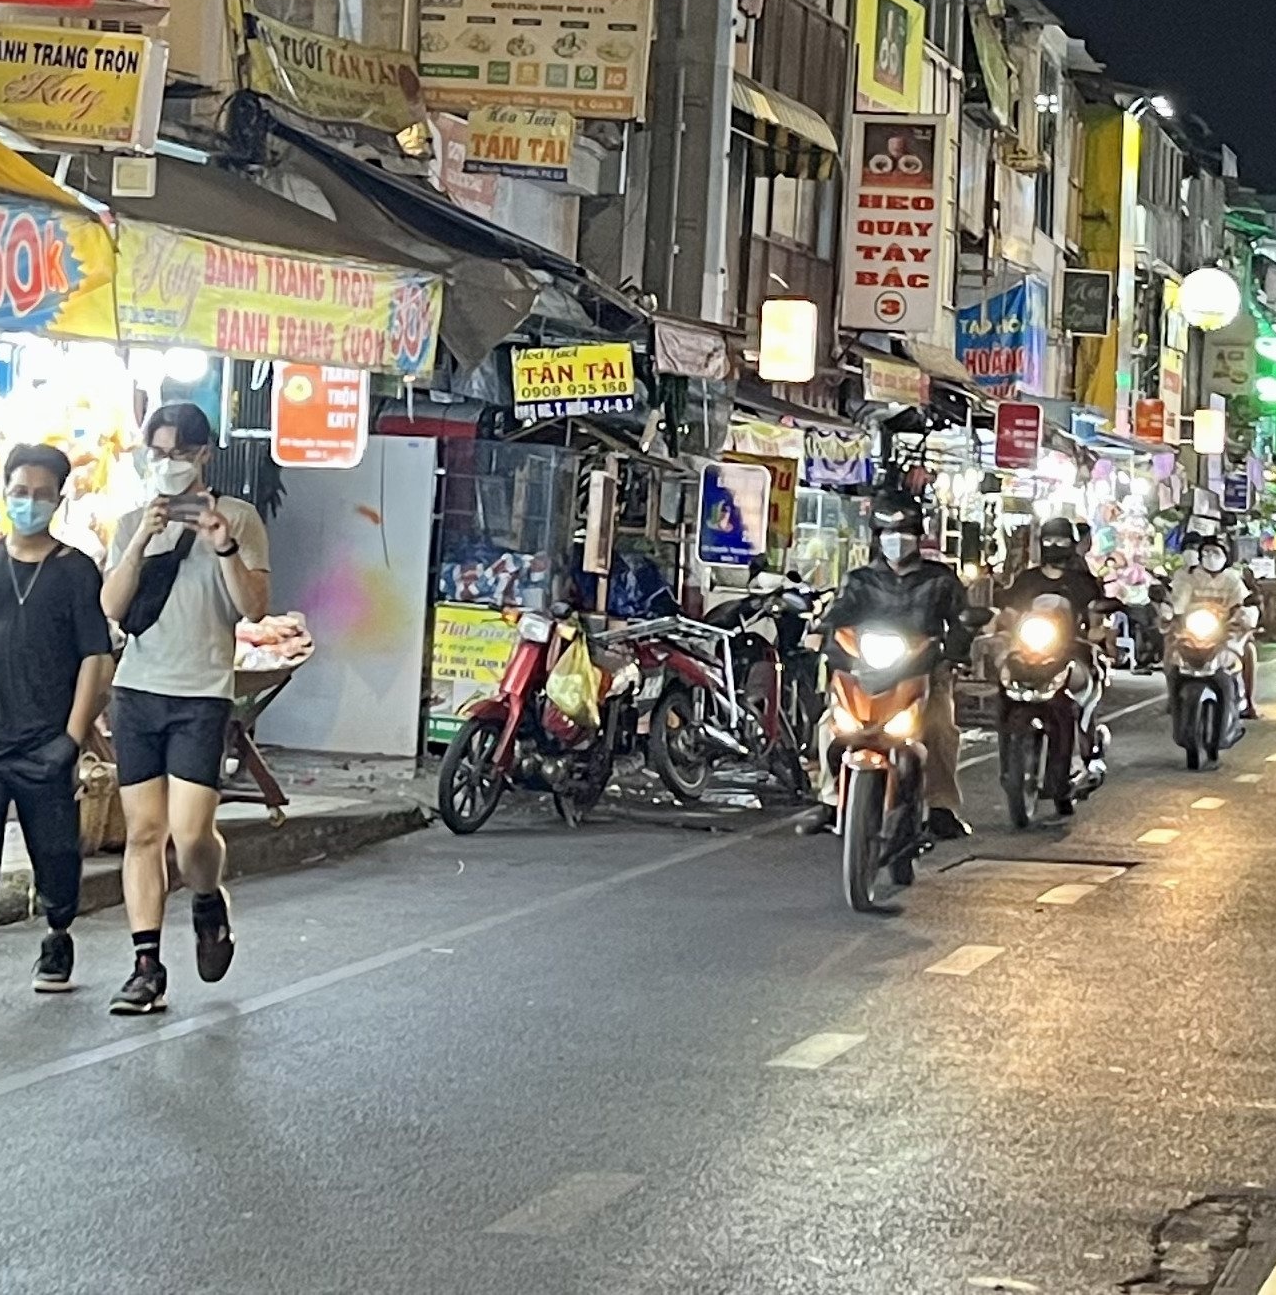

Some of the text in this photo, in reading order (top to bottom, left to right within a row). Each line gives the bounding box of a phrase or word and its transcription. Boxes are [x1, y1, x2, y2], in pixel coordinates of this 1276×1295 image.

[33, 37, 89, 70] TRÁNG
[857, 193, 935, 211] HEO
[856, 219, 934, 237] QUAY
[855, 242, 932, 263] TÂY
[880, 299, 901, 316] 3
